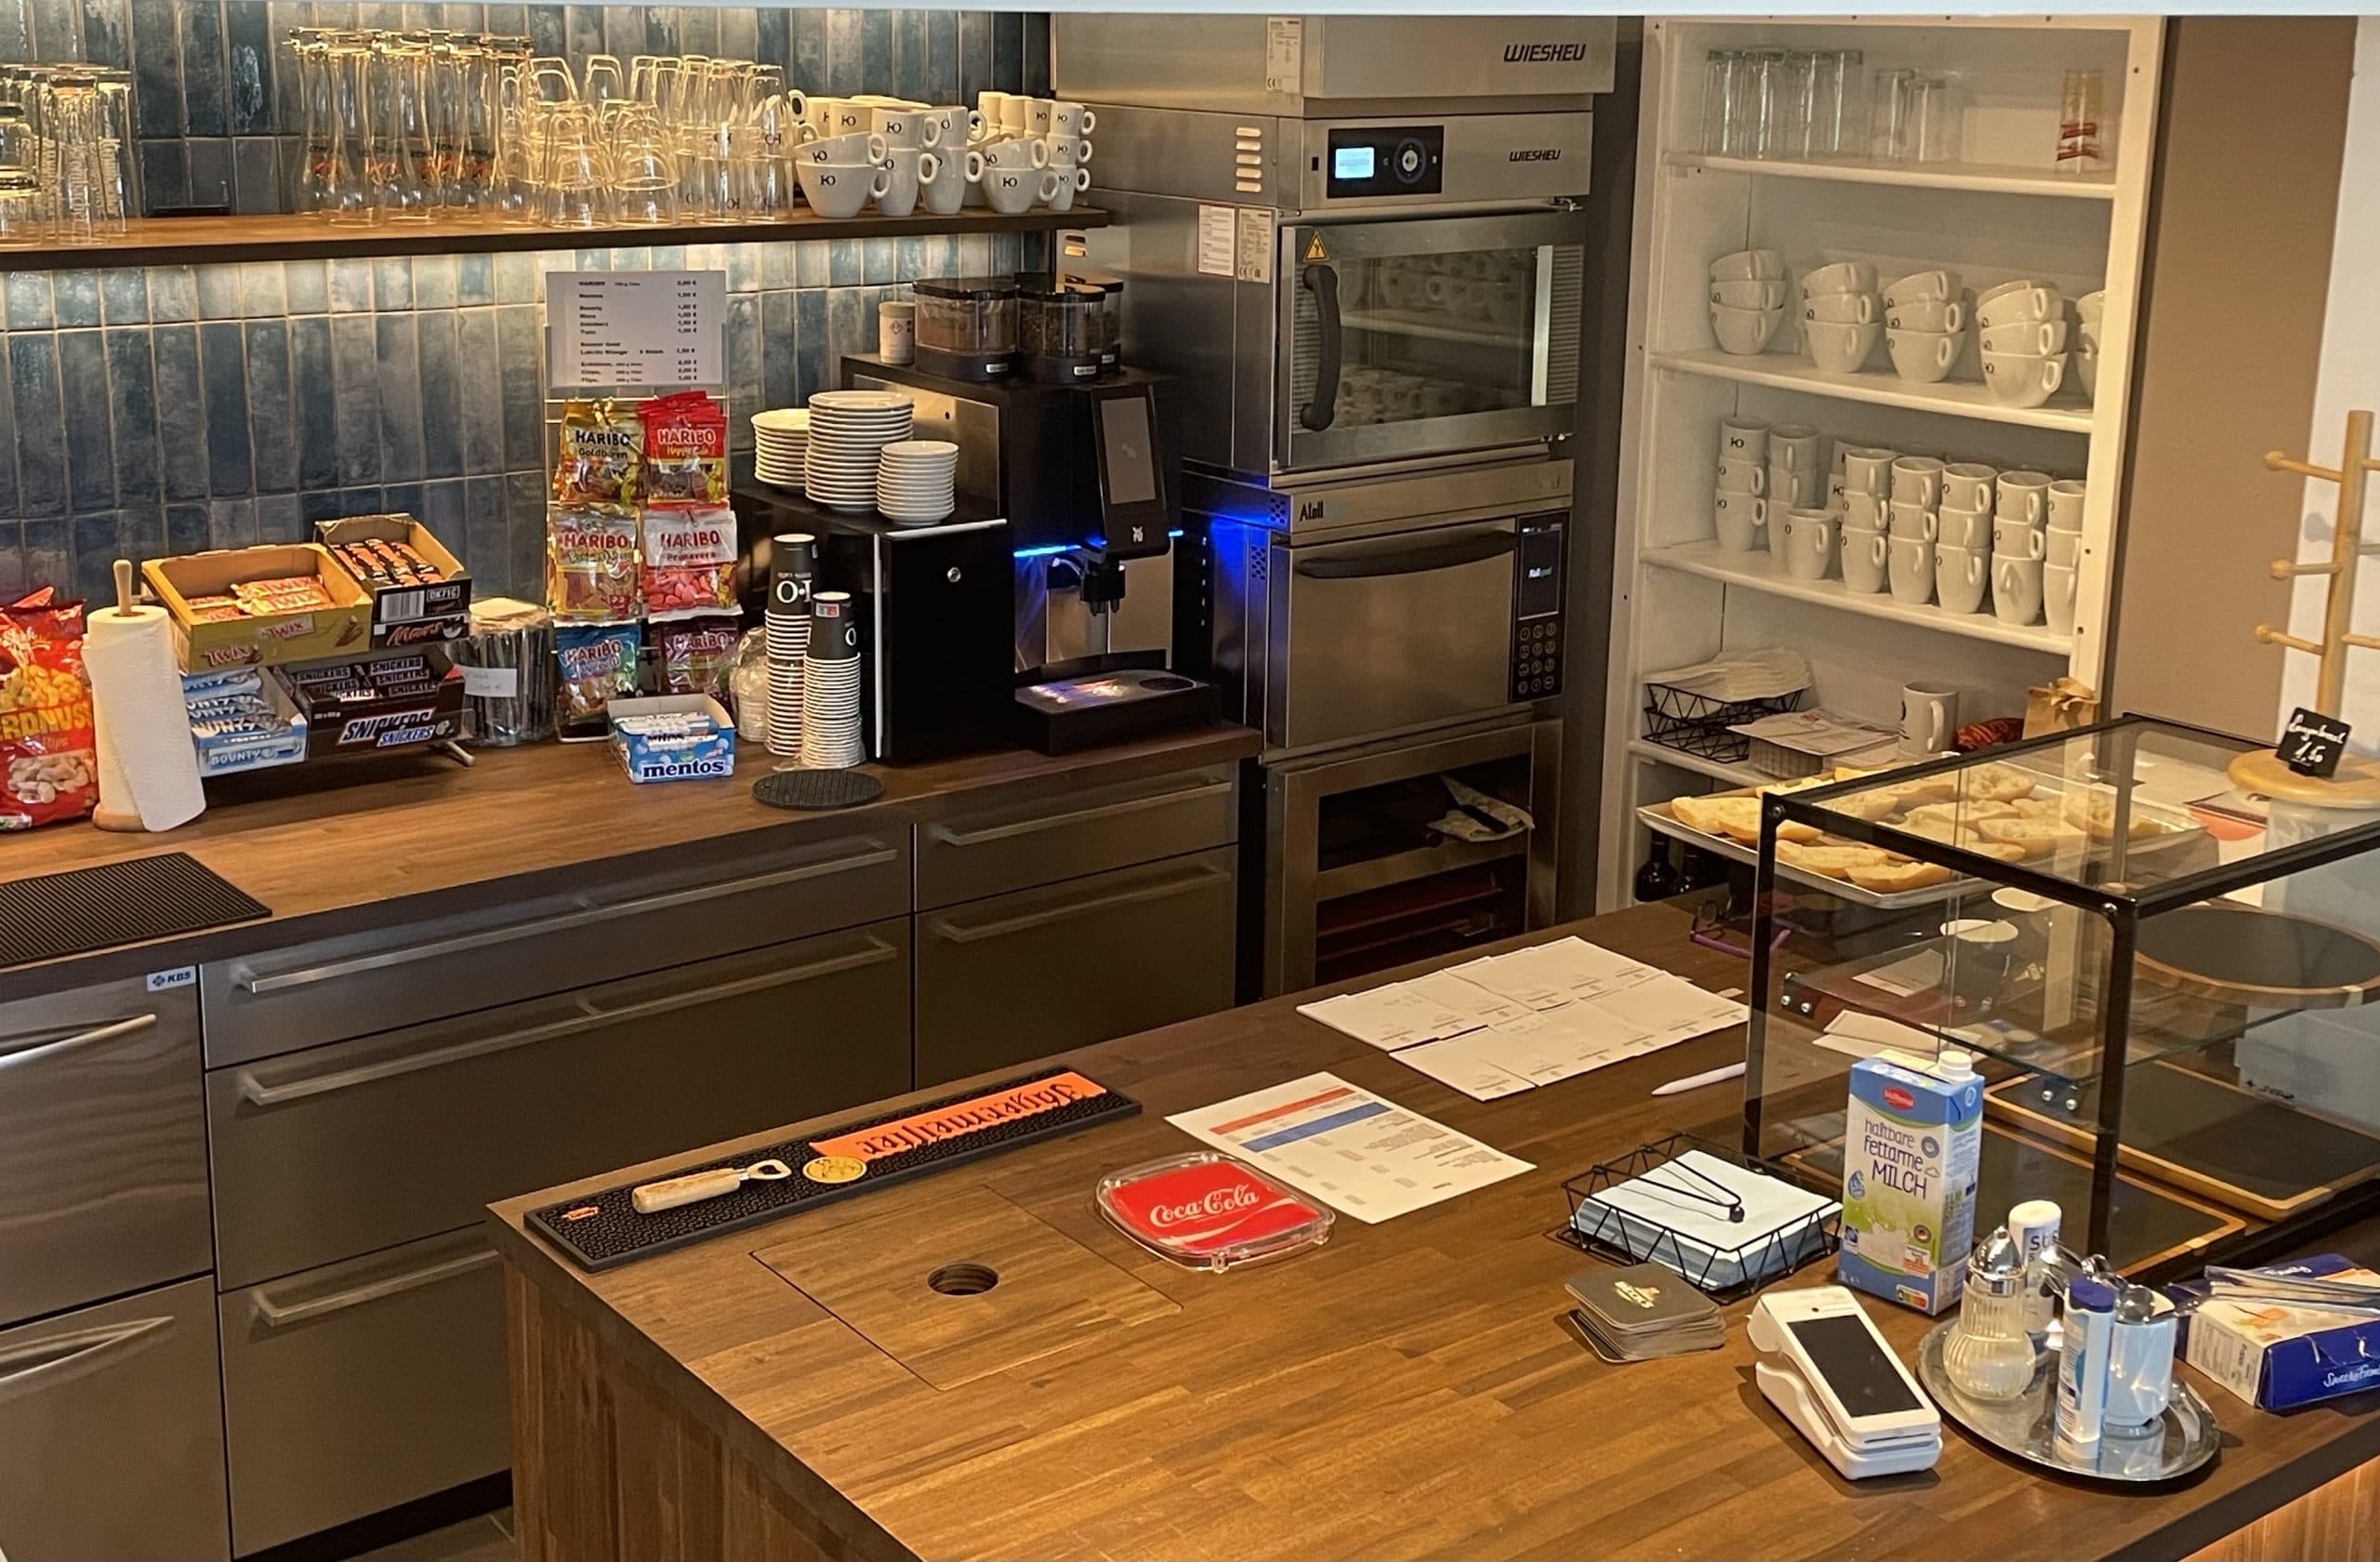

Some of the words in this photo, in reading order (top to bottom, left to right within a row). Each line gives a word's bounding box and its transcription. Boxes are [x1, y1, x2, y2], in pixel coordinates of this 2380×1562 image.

[1503, 44, 1586, 62] WIESHEU
[1509, 149, 1561, 162] WIESHEU
[575, 430, 631, 447] HARIBO
[658, 428, 717, 445] HARIBO
[563, 533, 629, 549] HARIBO
[661, 530, 721, 548] HARIBO
[673, 632, 730, 650] HARIBO
[564, 639, 624, 663] HARIBO
[372, 656, 423, 673] SNICKERS
[377, 669, 430, 685] SNICKERS
[380, 725, 434, 746] SNICKERS
[211, 748, 261, 765] BOUNTY
[643, 760, 725, 778] mentos
[167, 971, 191, 983] KBS
[1865, 1118, 1915, 1149] haltbare
[1863, 1135, 1924, 1172] fettarme
[1871, 1159, 1927, 1200] MILCH
